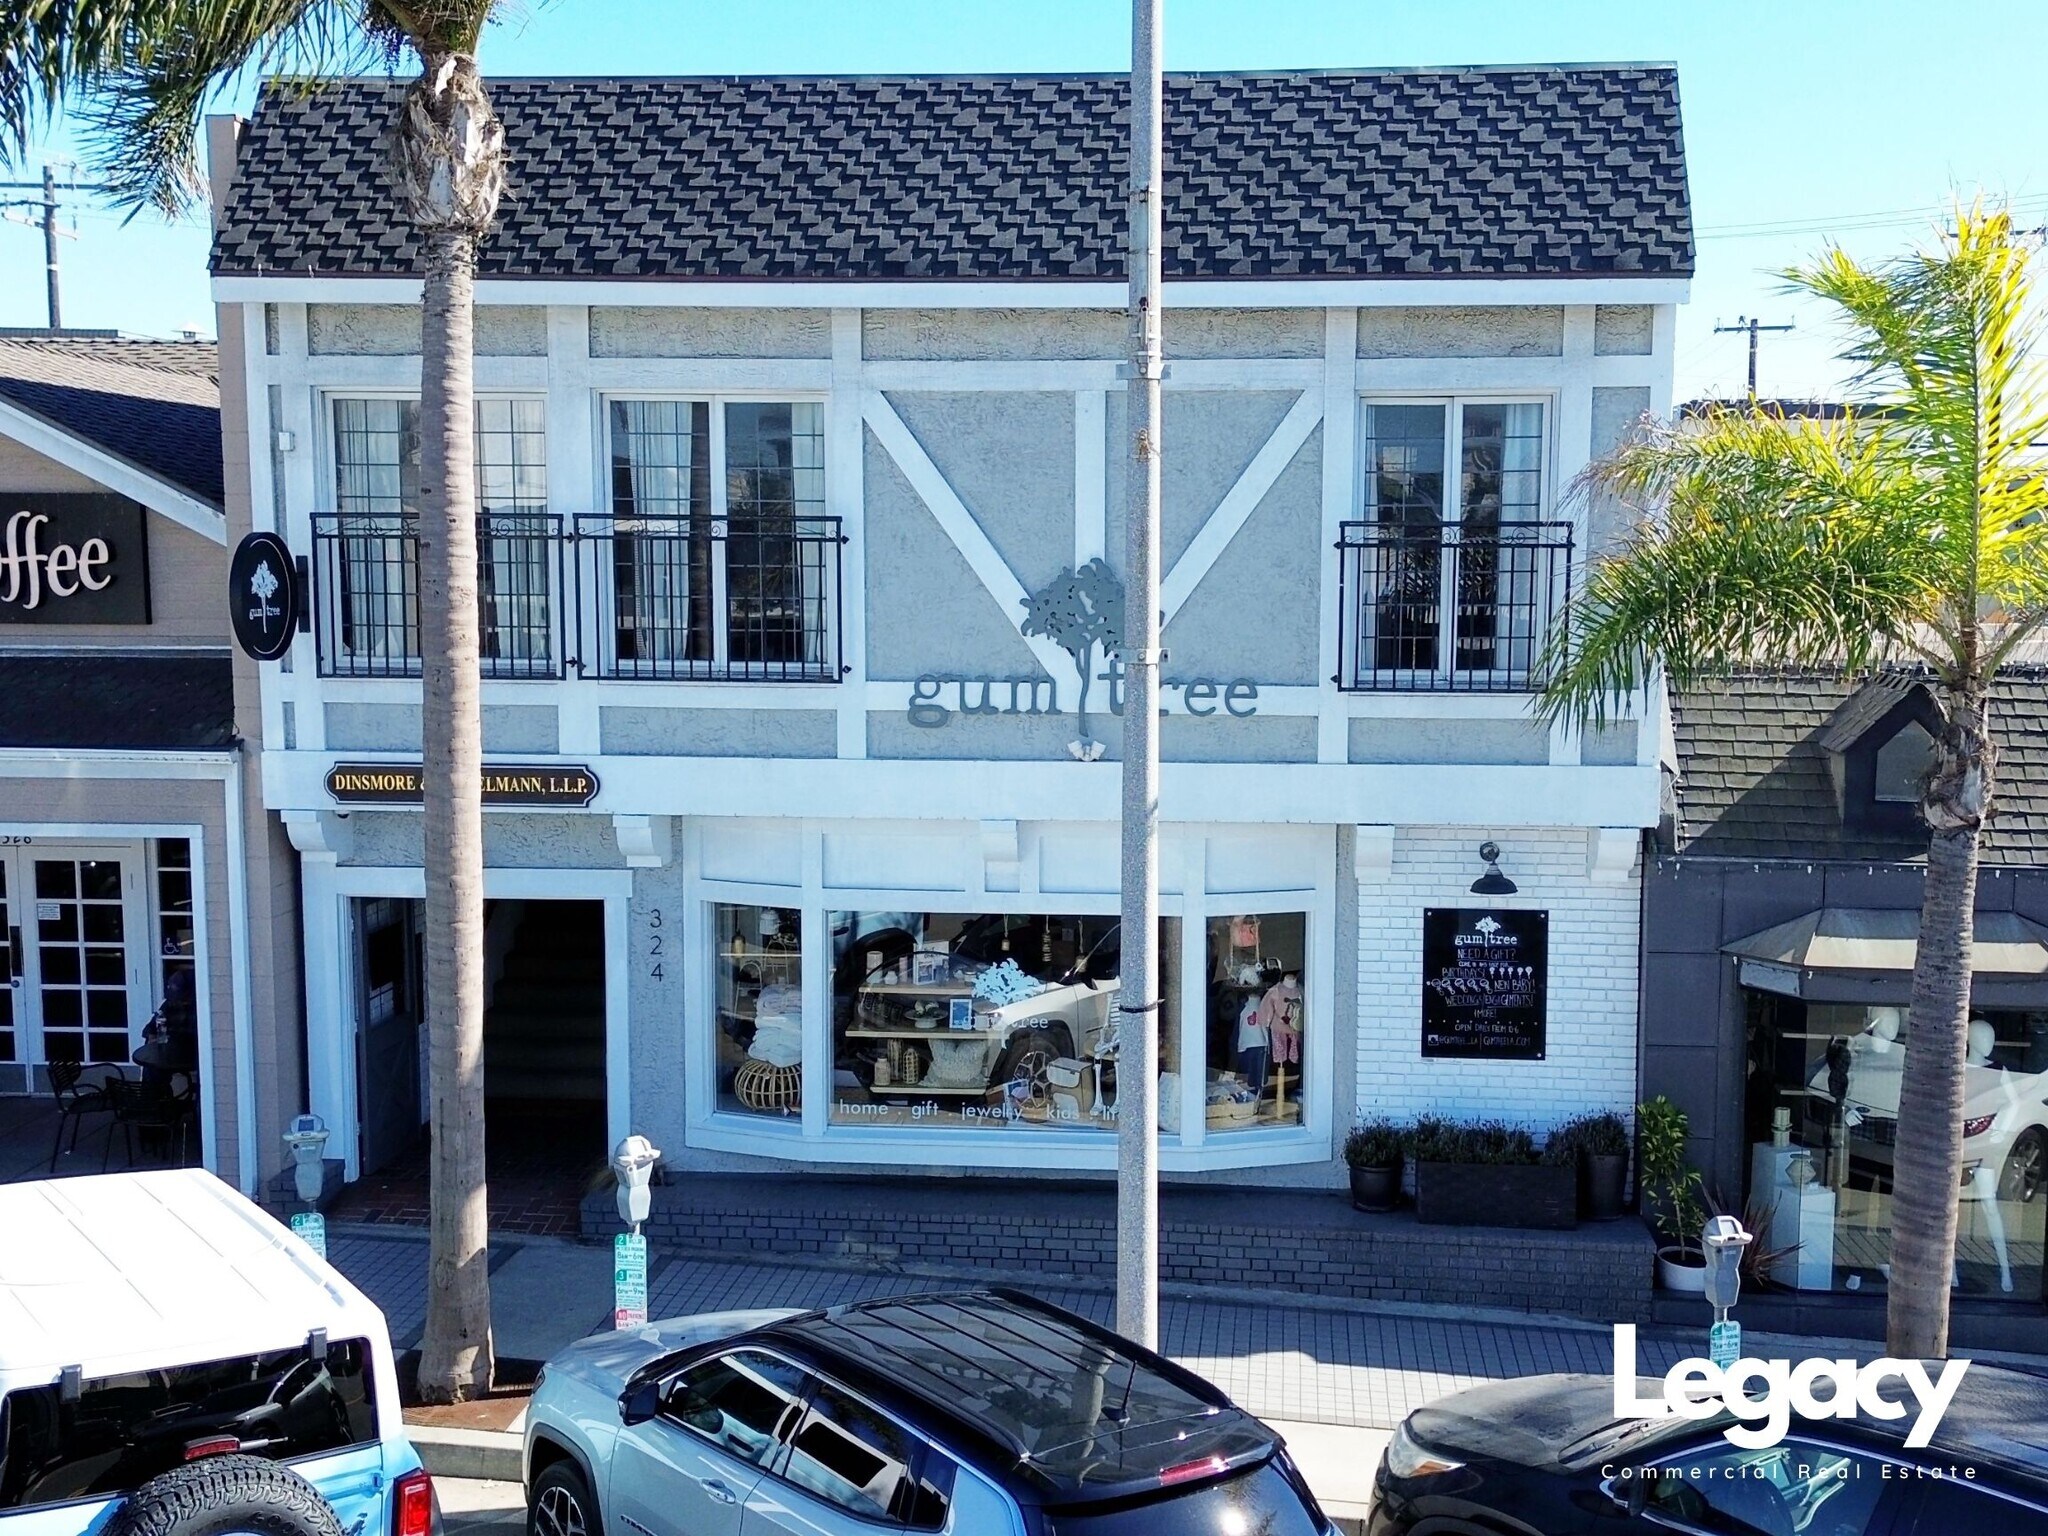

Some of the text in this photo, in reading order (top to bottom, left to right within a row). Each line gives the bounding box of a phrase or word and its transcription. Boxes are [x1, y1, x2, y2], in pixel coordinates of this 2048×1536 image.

[0, 511, 111, 609] ffee
[908, 660, 1258, 728] gum tee
[334, 775, 416, 790] DINSMORE
[480, 776, 546, 796] ELMANN,
[549, 777, 588, 793] L.L.P.
[650, 908, 664, 982] 324
[1454, 934, 1518, 946] gum tree
[1457, 948, 1516, 960] NEED A GIFT?
[1454, 1023, 1472, 1031] OPEN
[840, 1099, 888, 1115] home
[912, 1101, 939, 1119] gift
[618, 1235, 624, 1245] 2
[618, 1271, 624, 1280] 3
